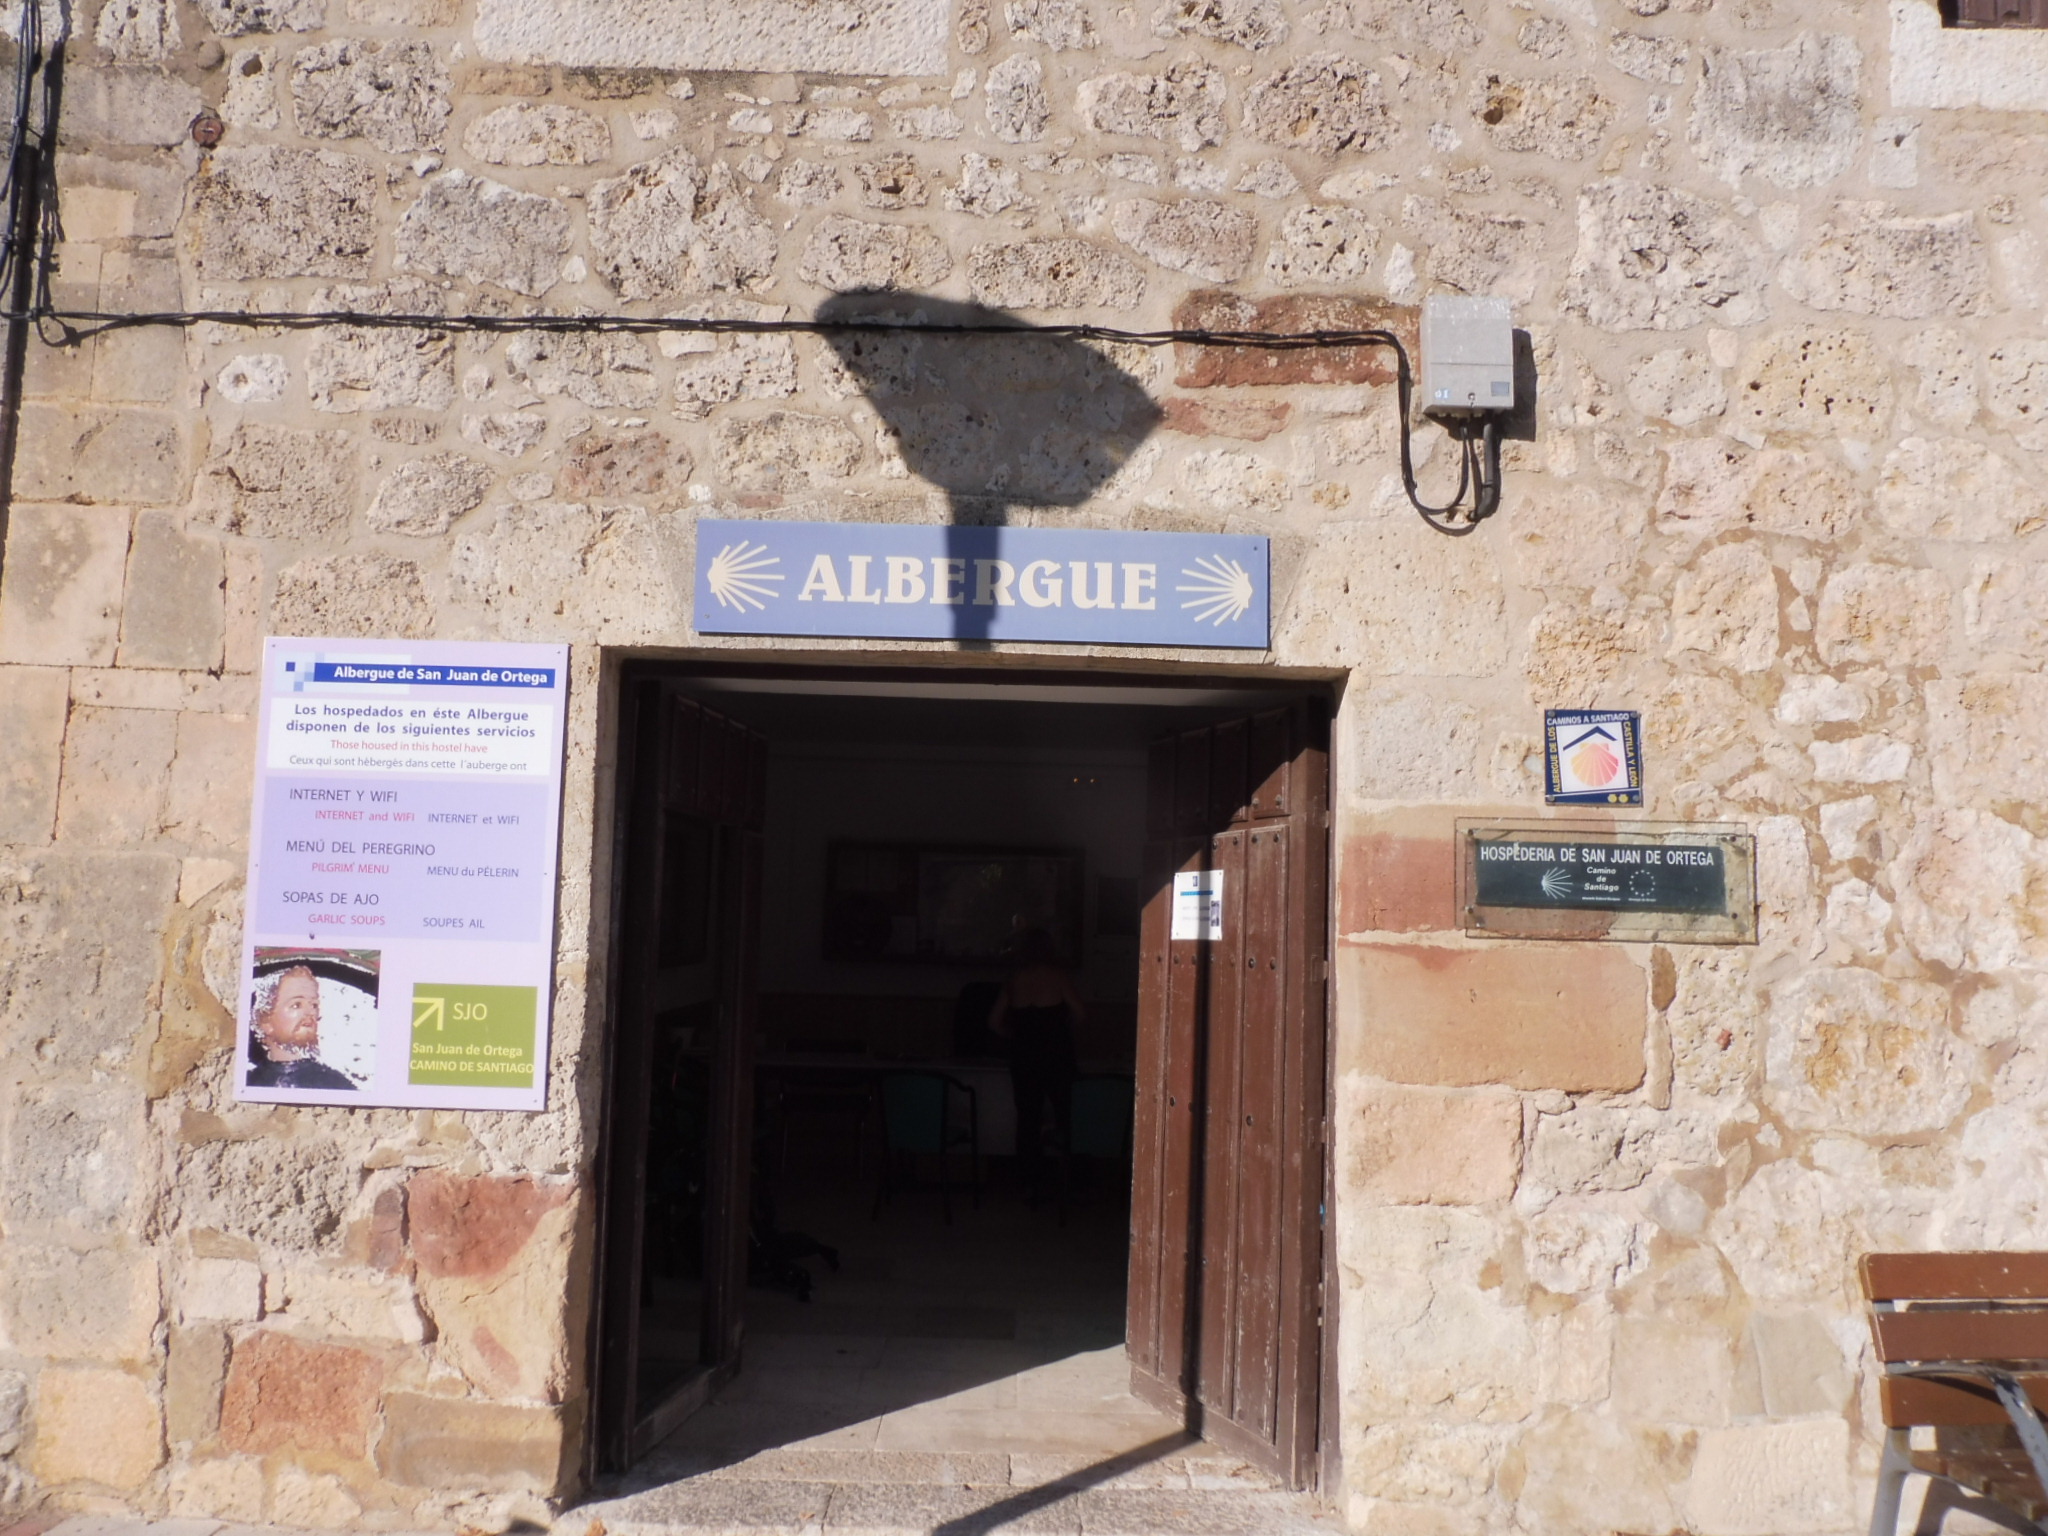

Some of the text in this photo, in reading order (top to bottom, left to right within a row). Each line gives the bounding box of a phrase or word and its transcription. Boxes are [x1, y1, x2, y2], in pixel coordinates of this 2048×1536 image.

[797, 553, 1156, 611] ALBERGUE
[334, 666, 548, 684] Albergue de San Juan de Ortega
[295, 704, 529, 723] Los hospedados en éste Albergue
[1546, 713, 1630, 726] CAMINOS A SANTIAGO
[286, 721, 536, 738] disponen de los siguientes servicios
[330, 739, 488, 754] Those housed in this hostel have
[1624, 722, 1634, 758] CASTILLA
[289, 755, 314, 766] Ceux
[316, 756, 332, 768] qui
[334, 758, 355, 768] sont
[405, 758, 429, 768] dans
[430, 759, 456, 769] cette
[510, 762, 527, 772] ont
[1547, 726, 1561, 793] ALBERGUE DE LOS
[290, 788, 398, 802] INTERNET Y WIFI
[315, 810, 415, 822] INTERNET and WIFI
[428, 814, 520, 826] INTERNET et WIFI
[286, 838, 436, 856] MENÚ DEL PEREGRINO
[1480, 846, 1714, 866] HOSPEDERIA DE SAN JUAN DE ORTEGA
[358, 864, 389, 874] MENU
[427, 866, 458, 876] MENU
[461, 866, 475, 877] du
[1586, 866, 1616, 875] Camino
[1584, 883, 1619, 892] Santiago
[282, 891, 379, 906] SOPAS DE AJO
[308, 914, 386, 926] GARLIC SOUPS
[423, 917, 485, 928] SOUPES AIL
[452, 1002, 488, 1020] SJO
[412, 1042, 522, 1059] San Juan de Ortega
[410, 1060, 534, 1074] CAMINO DE SANTIAGO
